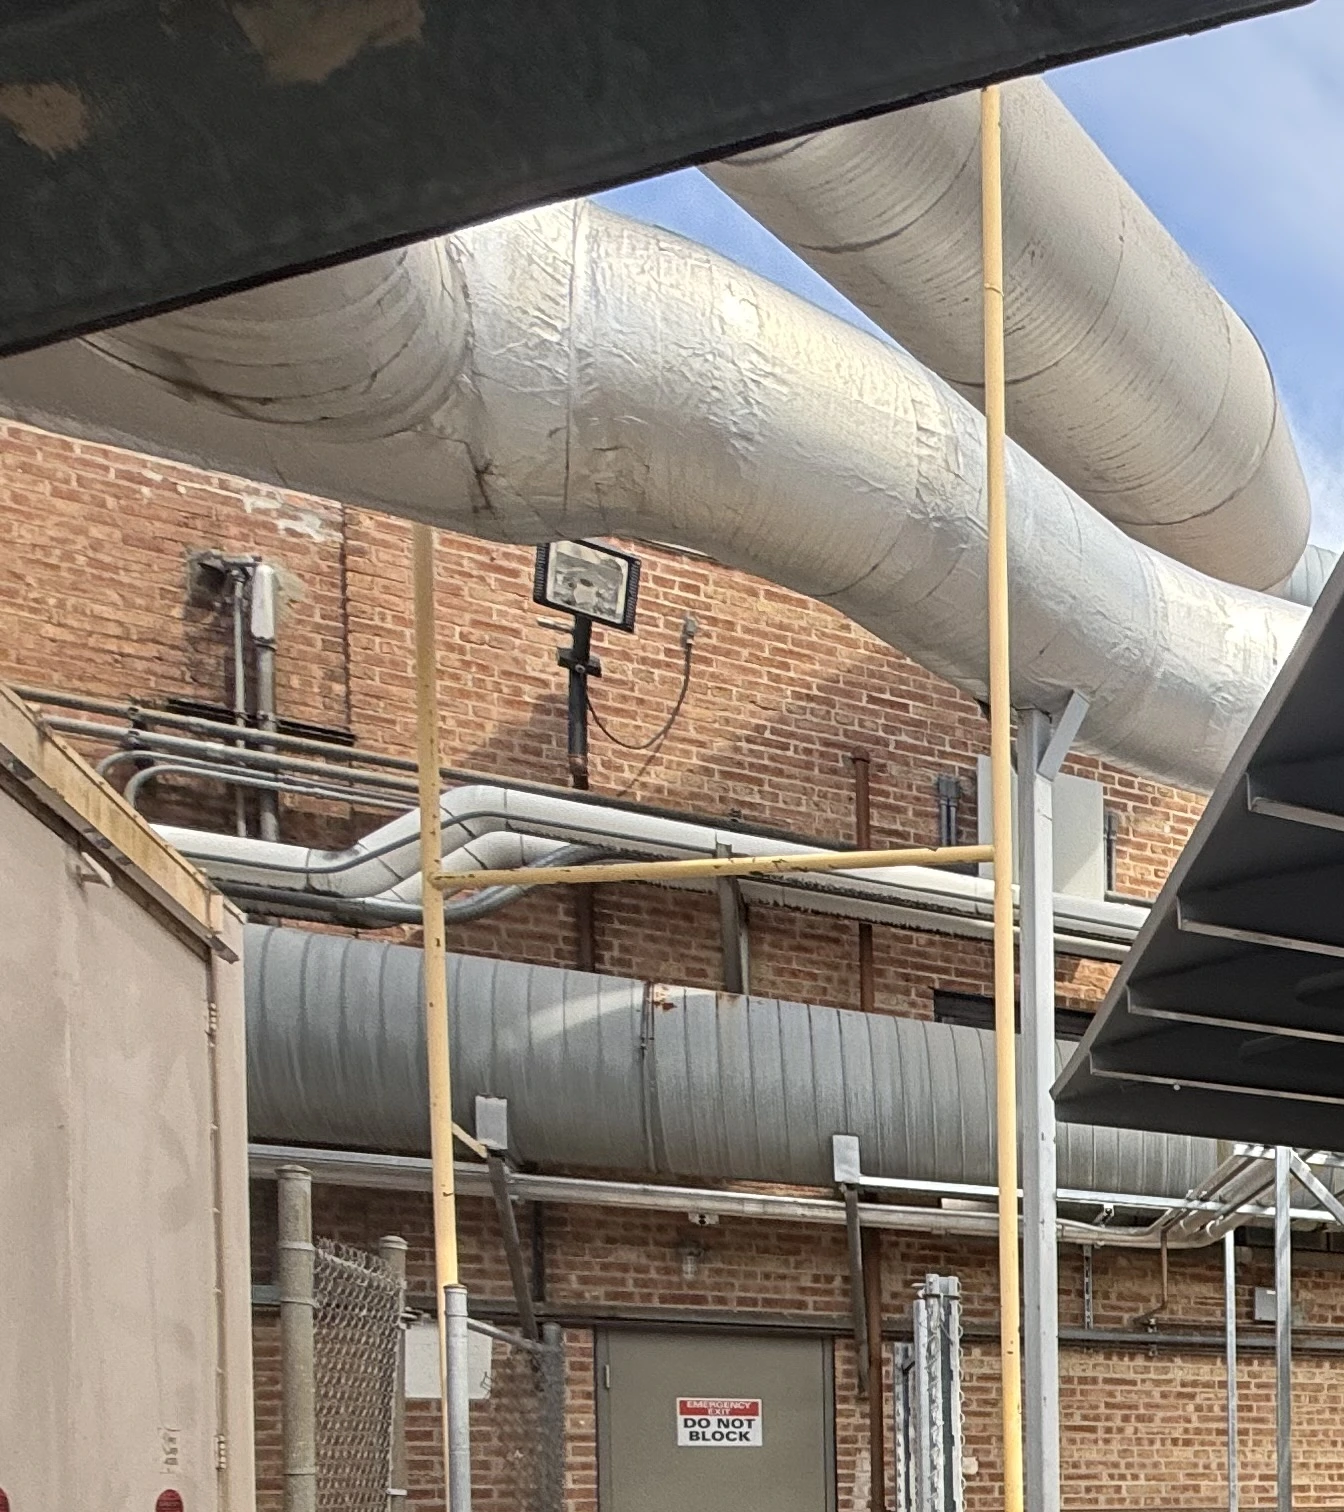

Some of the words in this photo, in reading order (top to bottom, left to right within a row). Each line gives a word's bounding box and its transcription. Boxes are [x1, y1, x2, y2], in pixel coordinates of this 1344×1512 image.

[686, 1401, 751, 1409] EMERGENCY
[707, 1408, 731, 1416] EXIT
[683, 1418, 711, 1429] DO
[717, 1418, 756, 1429] NOT
[689, 1431, 751, 1442] BLOCK
